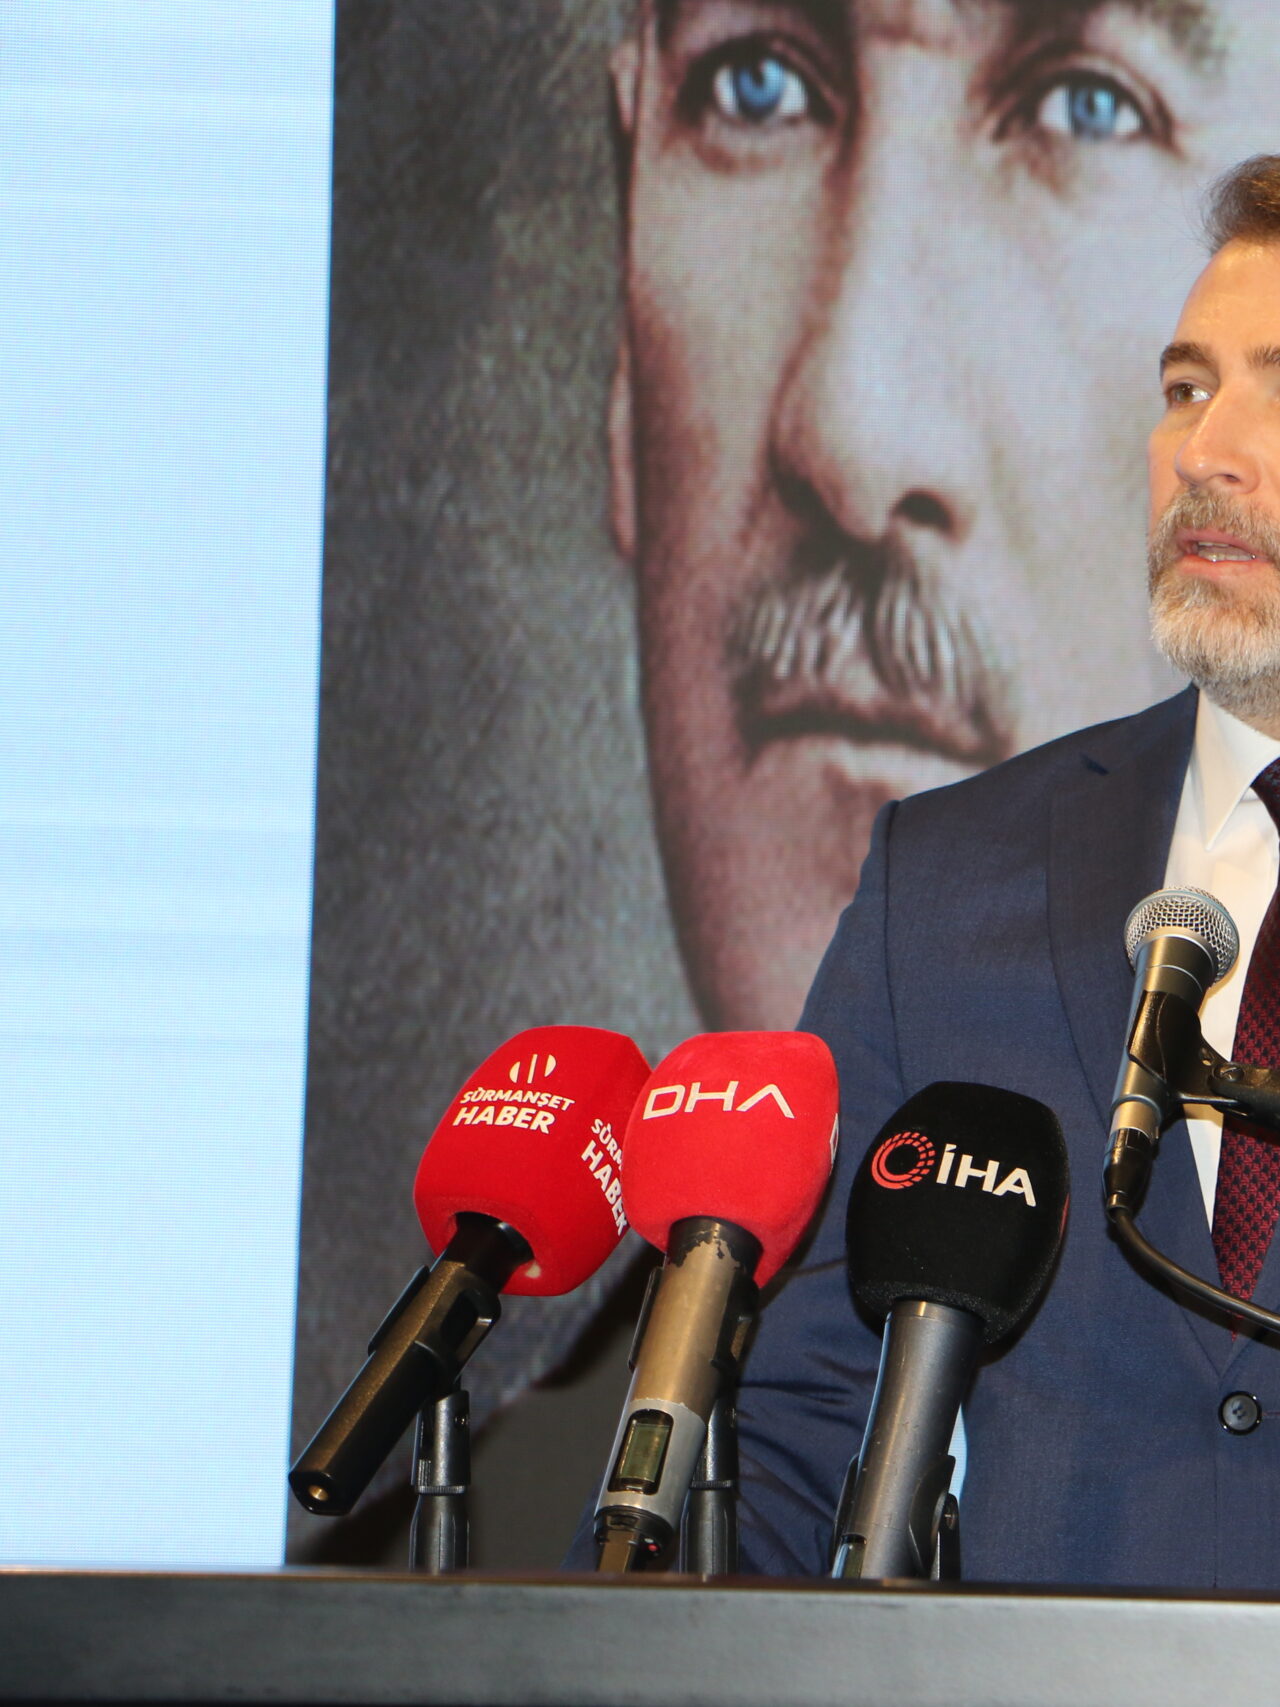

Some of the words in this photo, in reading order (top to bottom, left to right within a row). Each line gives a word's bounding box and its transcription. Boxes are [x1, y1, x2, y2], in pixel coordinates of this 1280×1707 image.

[459, 1086, 576, 1112] SÜRMANŞET
[642, 1080, 796, 1121] DHA
[452, 1105, 556, 1135] HABER
